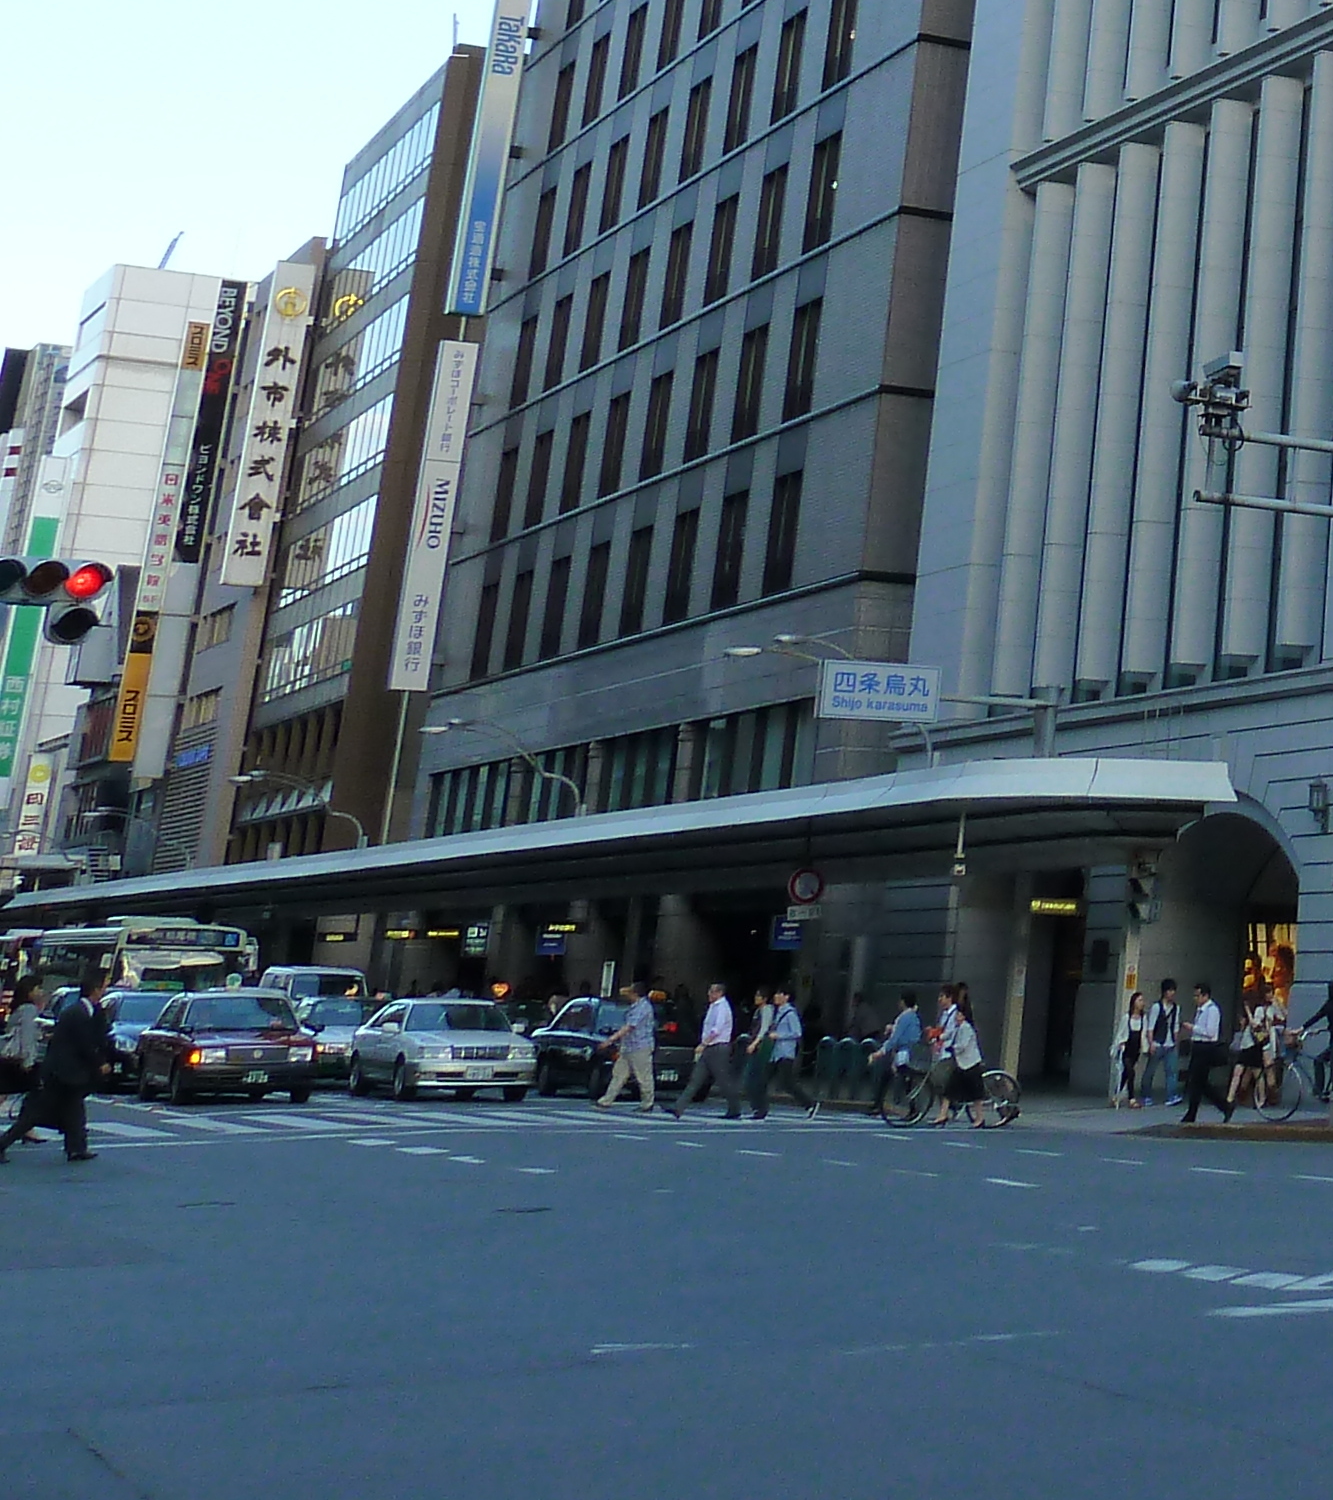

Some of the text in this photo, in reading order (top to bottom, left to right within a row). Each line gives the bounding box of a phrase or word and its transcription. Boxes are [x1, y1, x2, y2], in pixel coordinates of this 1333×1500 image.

[185, 324, 205, 366] プロミス
[211, 288, 239, 353] BEYOND
[426, 478, 450, 549] MIZUHO
[404, 594, 429, 672] みずほ銀行
[832, 695, 928, 713] Shijo karasuma
[833, 672, 930, 697] 四条烏丸
[117, 689, 141, 742] プロミス
